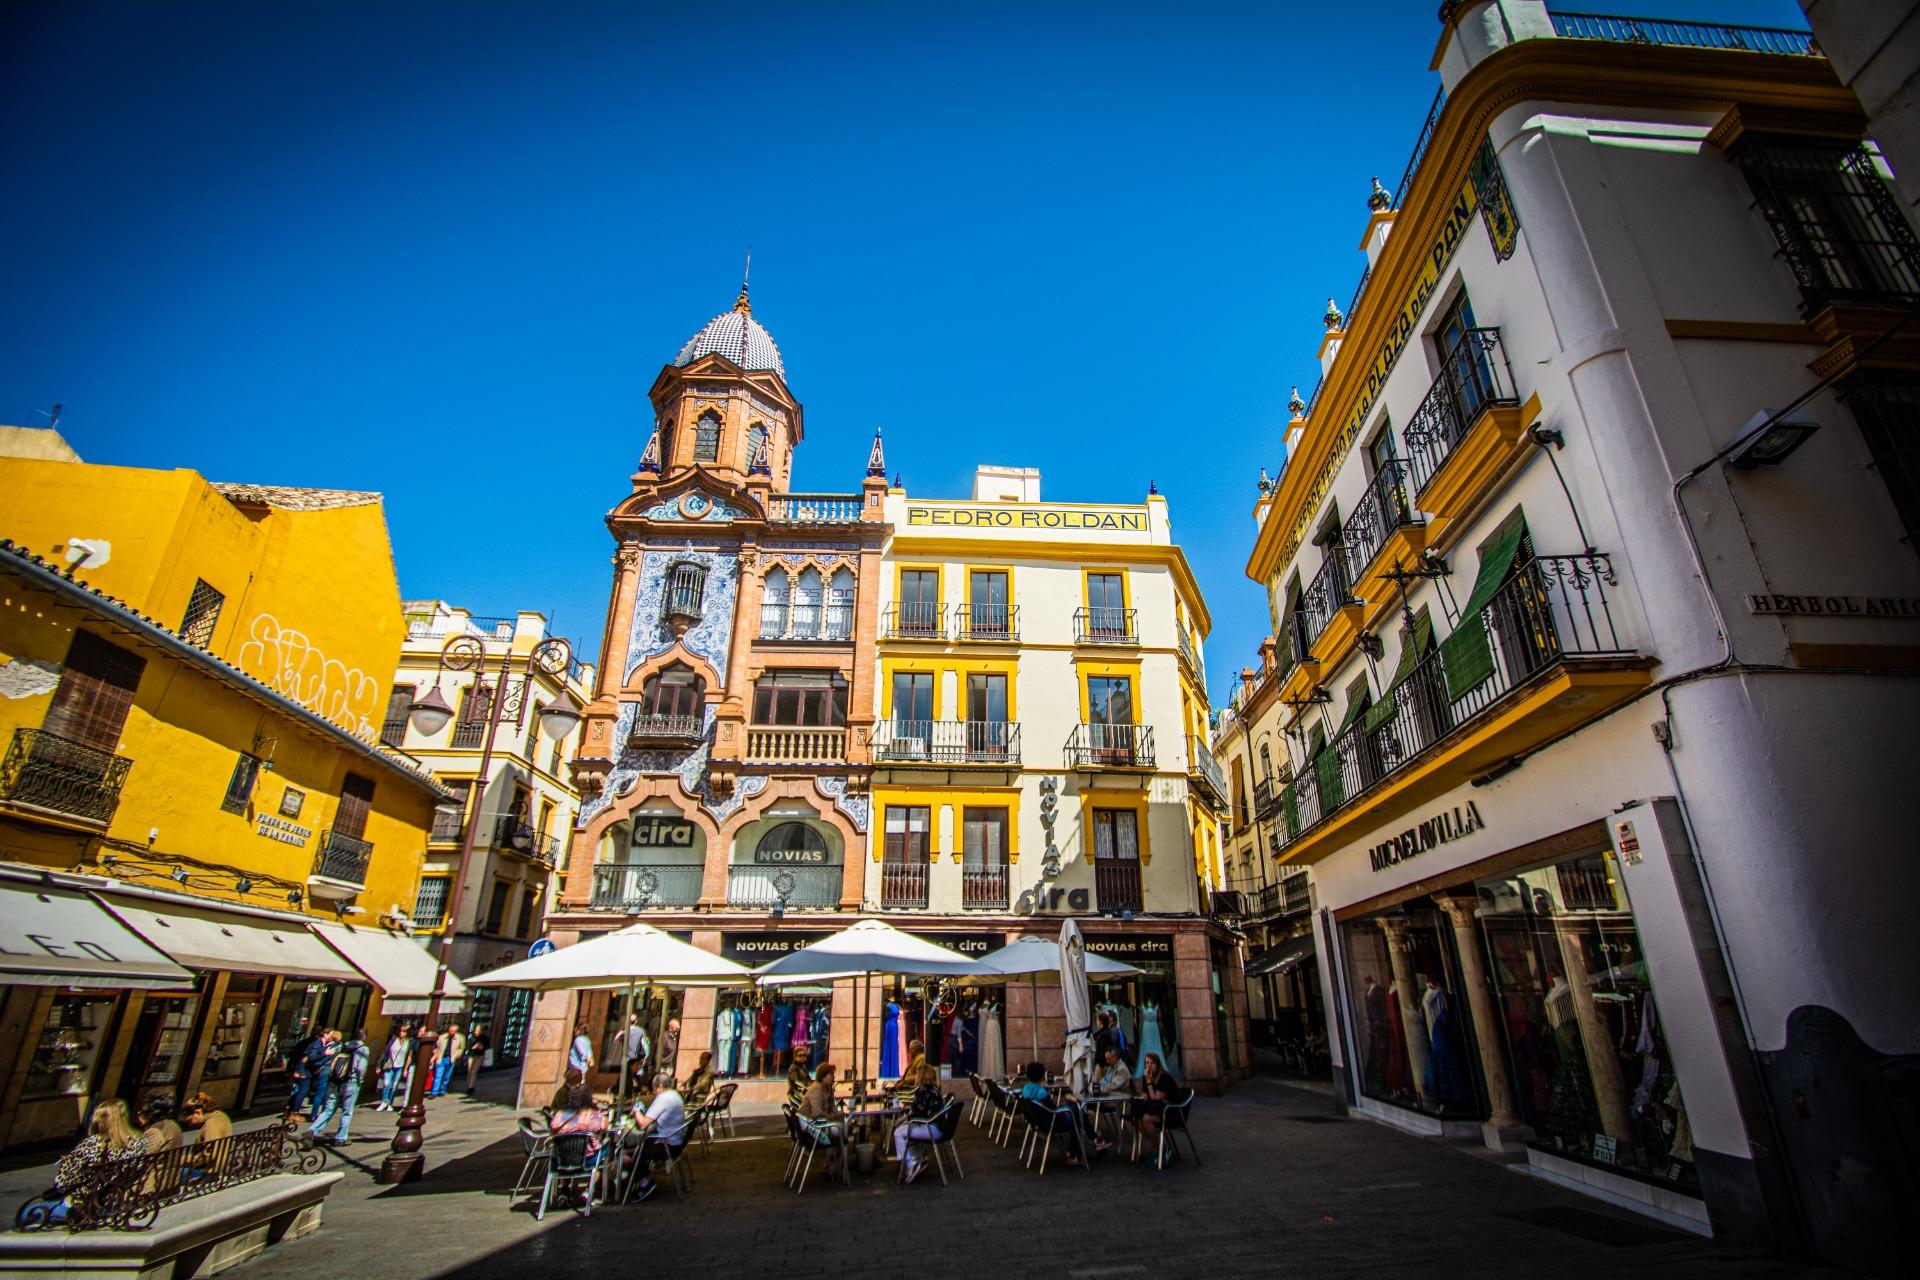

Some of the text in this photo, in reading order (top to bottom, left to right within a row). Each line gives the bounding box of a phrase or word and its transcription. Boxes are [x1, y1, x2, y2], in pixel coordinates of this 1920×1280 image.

[1269, 530, 1299, 584] NTIGUA
[1367, 312, 1411, 399] PLAZA
[1410, 277, 1433, 317] DEL
[1432, 192, 1470, 274] PAN
[908, 508, 1138, 530] PEDRO ROLDAN
[634, 818, 692, 845] cira
[1043, 776, 1061, 877] NOVIAS
[759, 850, 822, 861] NOVIAS
[1019, 879, 1090, 911] cira
[736, 941, 789, 951] NOVIAS
[958, 939, 988, 951] cira
[1085, 940, 1169, 952] NOVIAS cira
